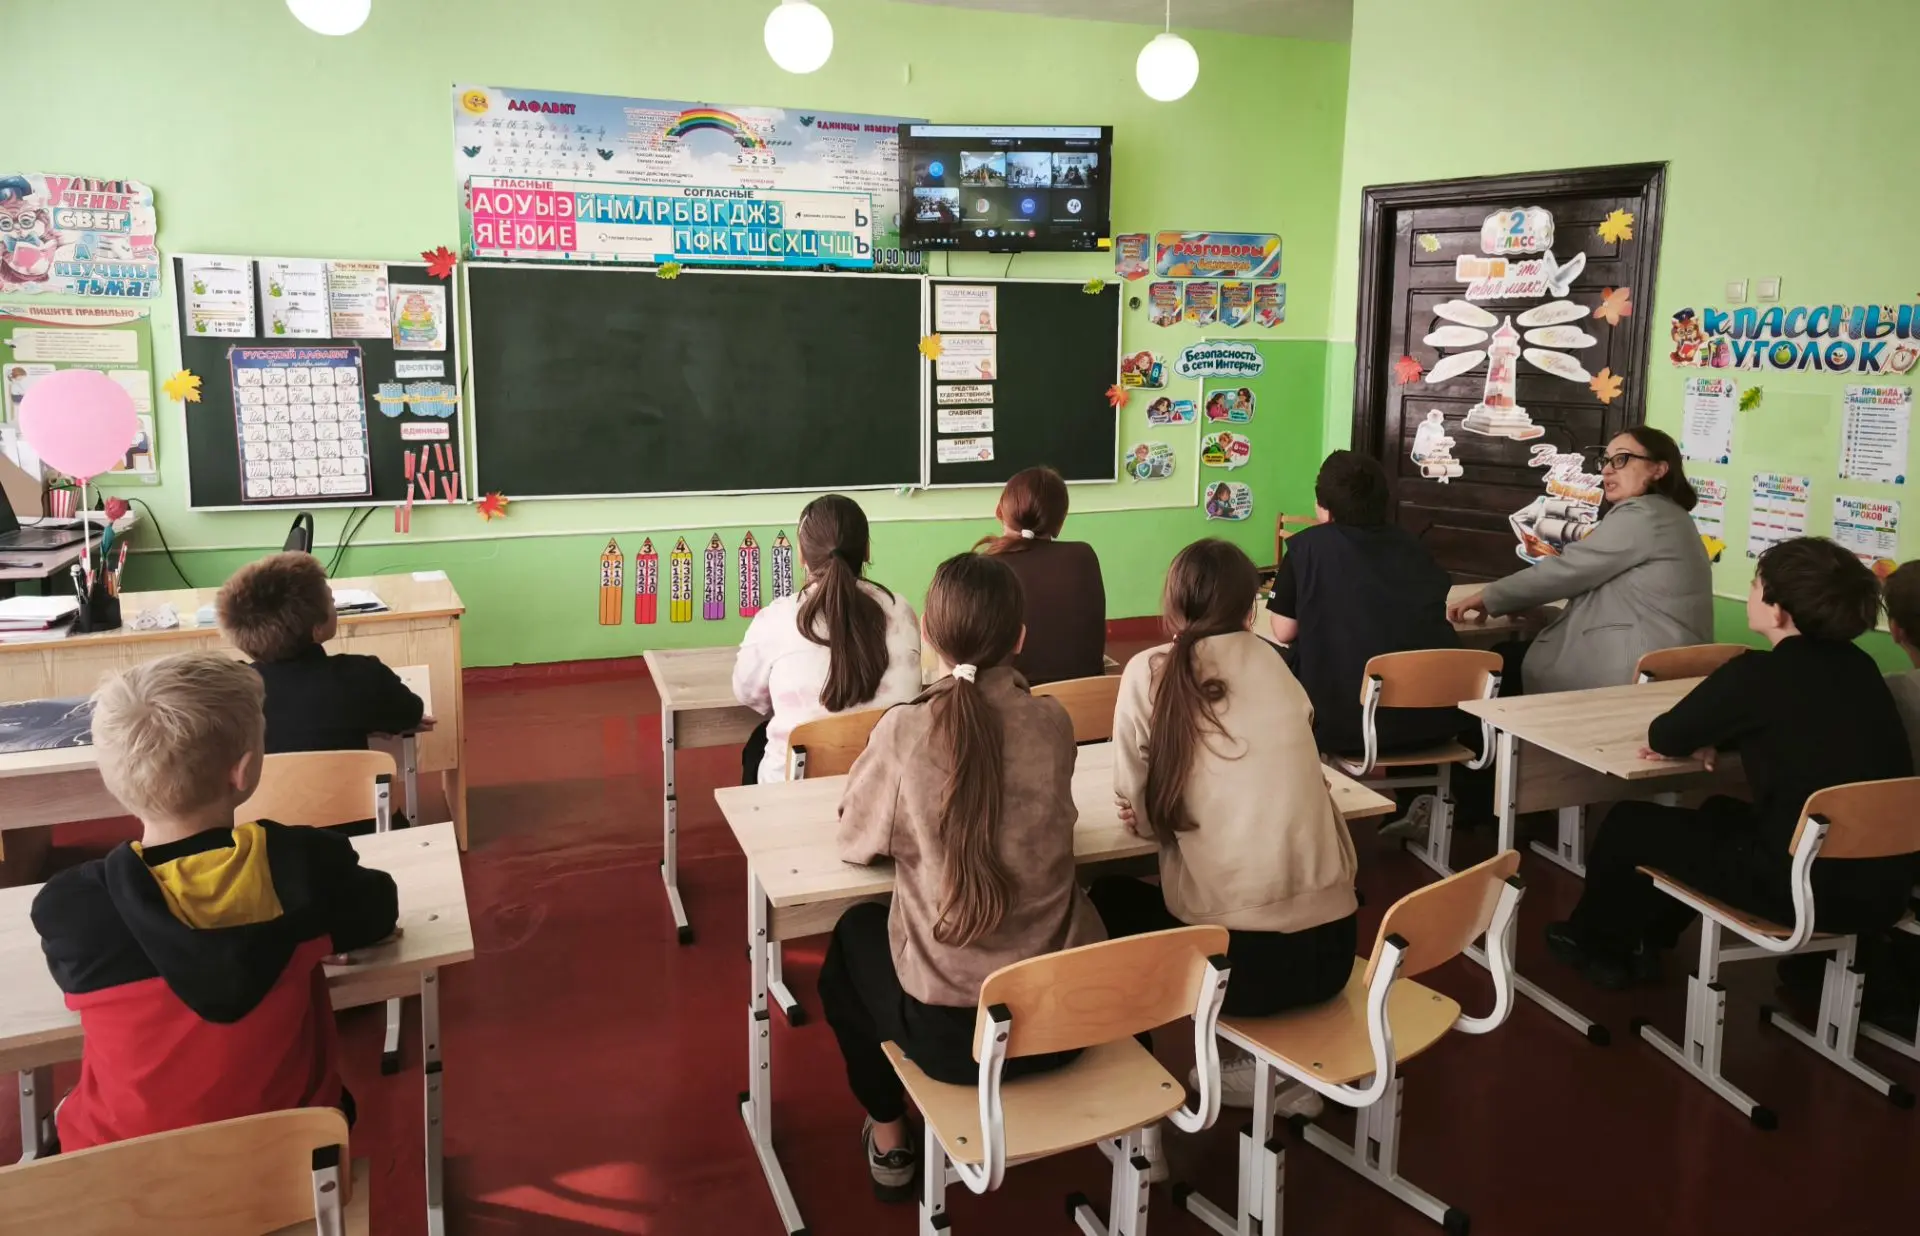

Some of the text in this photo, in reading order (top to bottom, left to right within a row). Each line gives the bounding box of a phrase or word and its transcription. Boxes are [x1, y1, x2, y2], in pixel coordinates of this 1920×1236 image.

[508, 99, 576, 114] АЛФАВИТ
[770, 124, 776, 133] 5
[817, 121, 860, 132] ЕДИНИЦЫ
[737, 155, 742, 164] 5
[752, 156, 757, 164] 2
[771, 156, 776, 165] 3
[493, 179, 553, 190] ГЛАСНЫЕ
[45, 177, 132, 210] УЧЕНЬЕ
[684, 188, 754, 199] СОГЛАСНЫЕ
[1510, 212, 1525, 234] 2
[1496, 235, 1535, 249] КЛАСС
[74, 244, 92, 260] А
[1173, 243, 1265, 258] РАЗГОВОРЫ
[887, 249, 920, 265] 90 100
[54, 263, 159, 280] НЕУЧЕНЬЕ
[29, 307, 134, 318] ПИШИТЕ ПРАВИЛЬНО
[243, 349, 349, 360] РУССКИЙ АЛФАВИТ
[1185, 349, 1257, 363] Безопасность
[1732, 341, 1887, 372] УГОЛОК
[1182, 359, 1262, 373] в сети Интернет
[1862, 388, 1898, 396] ПРАВИЛА
[1850, 396, 1877, 404] НАШЕГО
[1769, 475, 1793, 483] НАШИ
[1759, 481, 1805, 492] ИМЕНИННИКИ
[1843, 500, 1892, 513] РАСПИСАНИЕ
[1851, 509, 1883, 521] УРОКОВ
[712, 540, 719, 548] 5
[745, 538, 752, 546] 6
[609, 545, 616, 553] 2
[644, 544, 651, 553] 3
[677, 544, 684, 552] 4
[707, 552, 723, 560] 0 5
[740, 549, 758, 558] 0 6
[603, 560, 621, 568] 0 2
[639, 560, 656, 568] 0 3
[672, 559, 690, 567] 0 4
[706, 560, 723, 569] 1 4
[740, 558, 758, 566] 1 5
[603, 569, 620, 577] 1 1
[638, 568, 655, 576] 1 2
[672, 567, 690, 575] 1 3
[706, 569, 712, 577] 2
[741, 566, 758, 574] 2 4
[603, 578, 620, 586] 2 0
[638, 577, 656, 585] 2 1
[673, 575, 690, 583] 2 2
[706, 577, 723, 585] 3 2
[752, 574, 758, 582] 3
[638, 586, 655, 594] 3 0
[673, 584, 690, 592] 3 1
[705, 585, 723, 593] 4 1
[741, 583, 747, 591] 4
[673, 592, 690, 600] 4 0
[705, 593, 723, 602] 5 0
[741, 591, 758, 599] 5 1
[741, 599, 758, 607] 6 0
